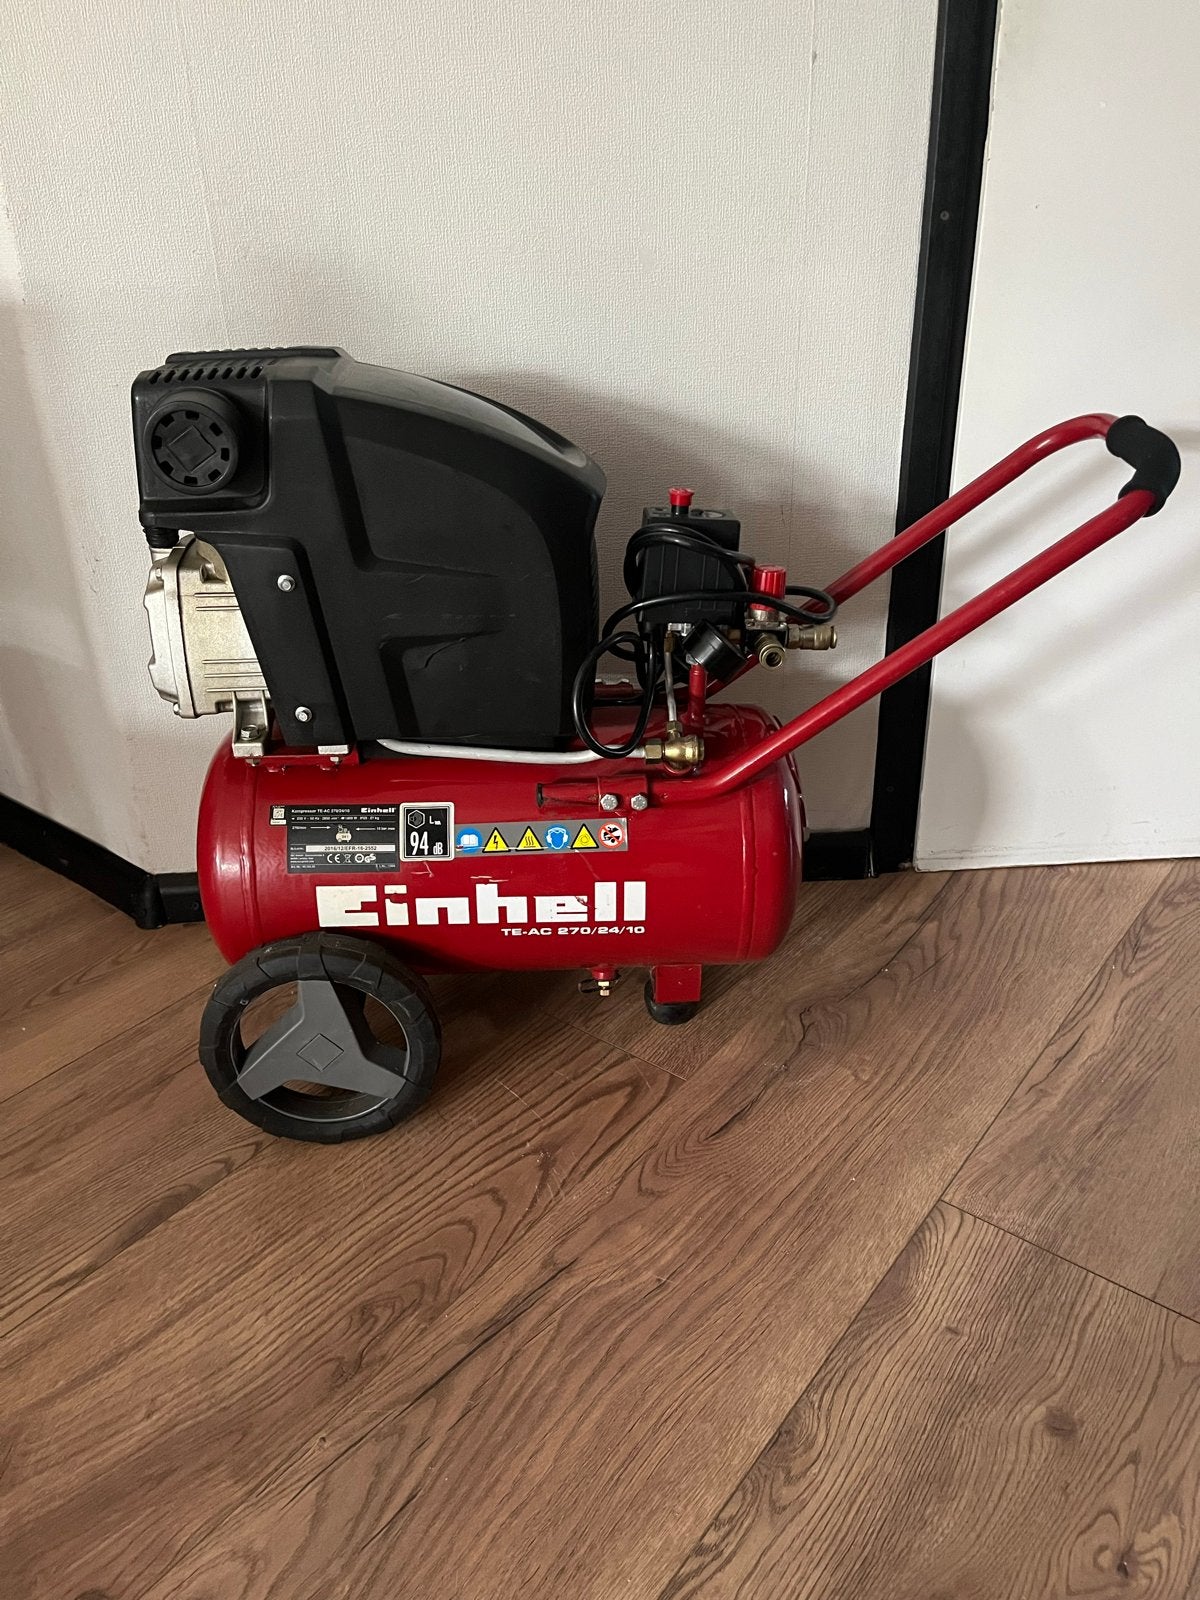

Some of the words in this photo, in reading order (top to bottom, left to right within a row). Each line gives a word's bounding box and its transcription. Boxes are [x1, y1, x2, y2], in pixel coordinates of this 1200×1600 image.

[410, 831, 429, 856] 94
[433, 842, 444, 855] dB
[315, 881, 646, 927] Einhell
[501, 927, 552, 936] TE-AC
[557, 925, 646, 936] 270/24/10
